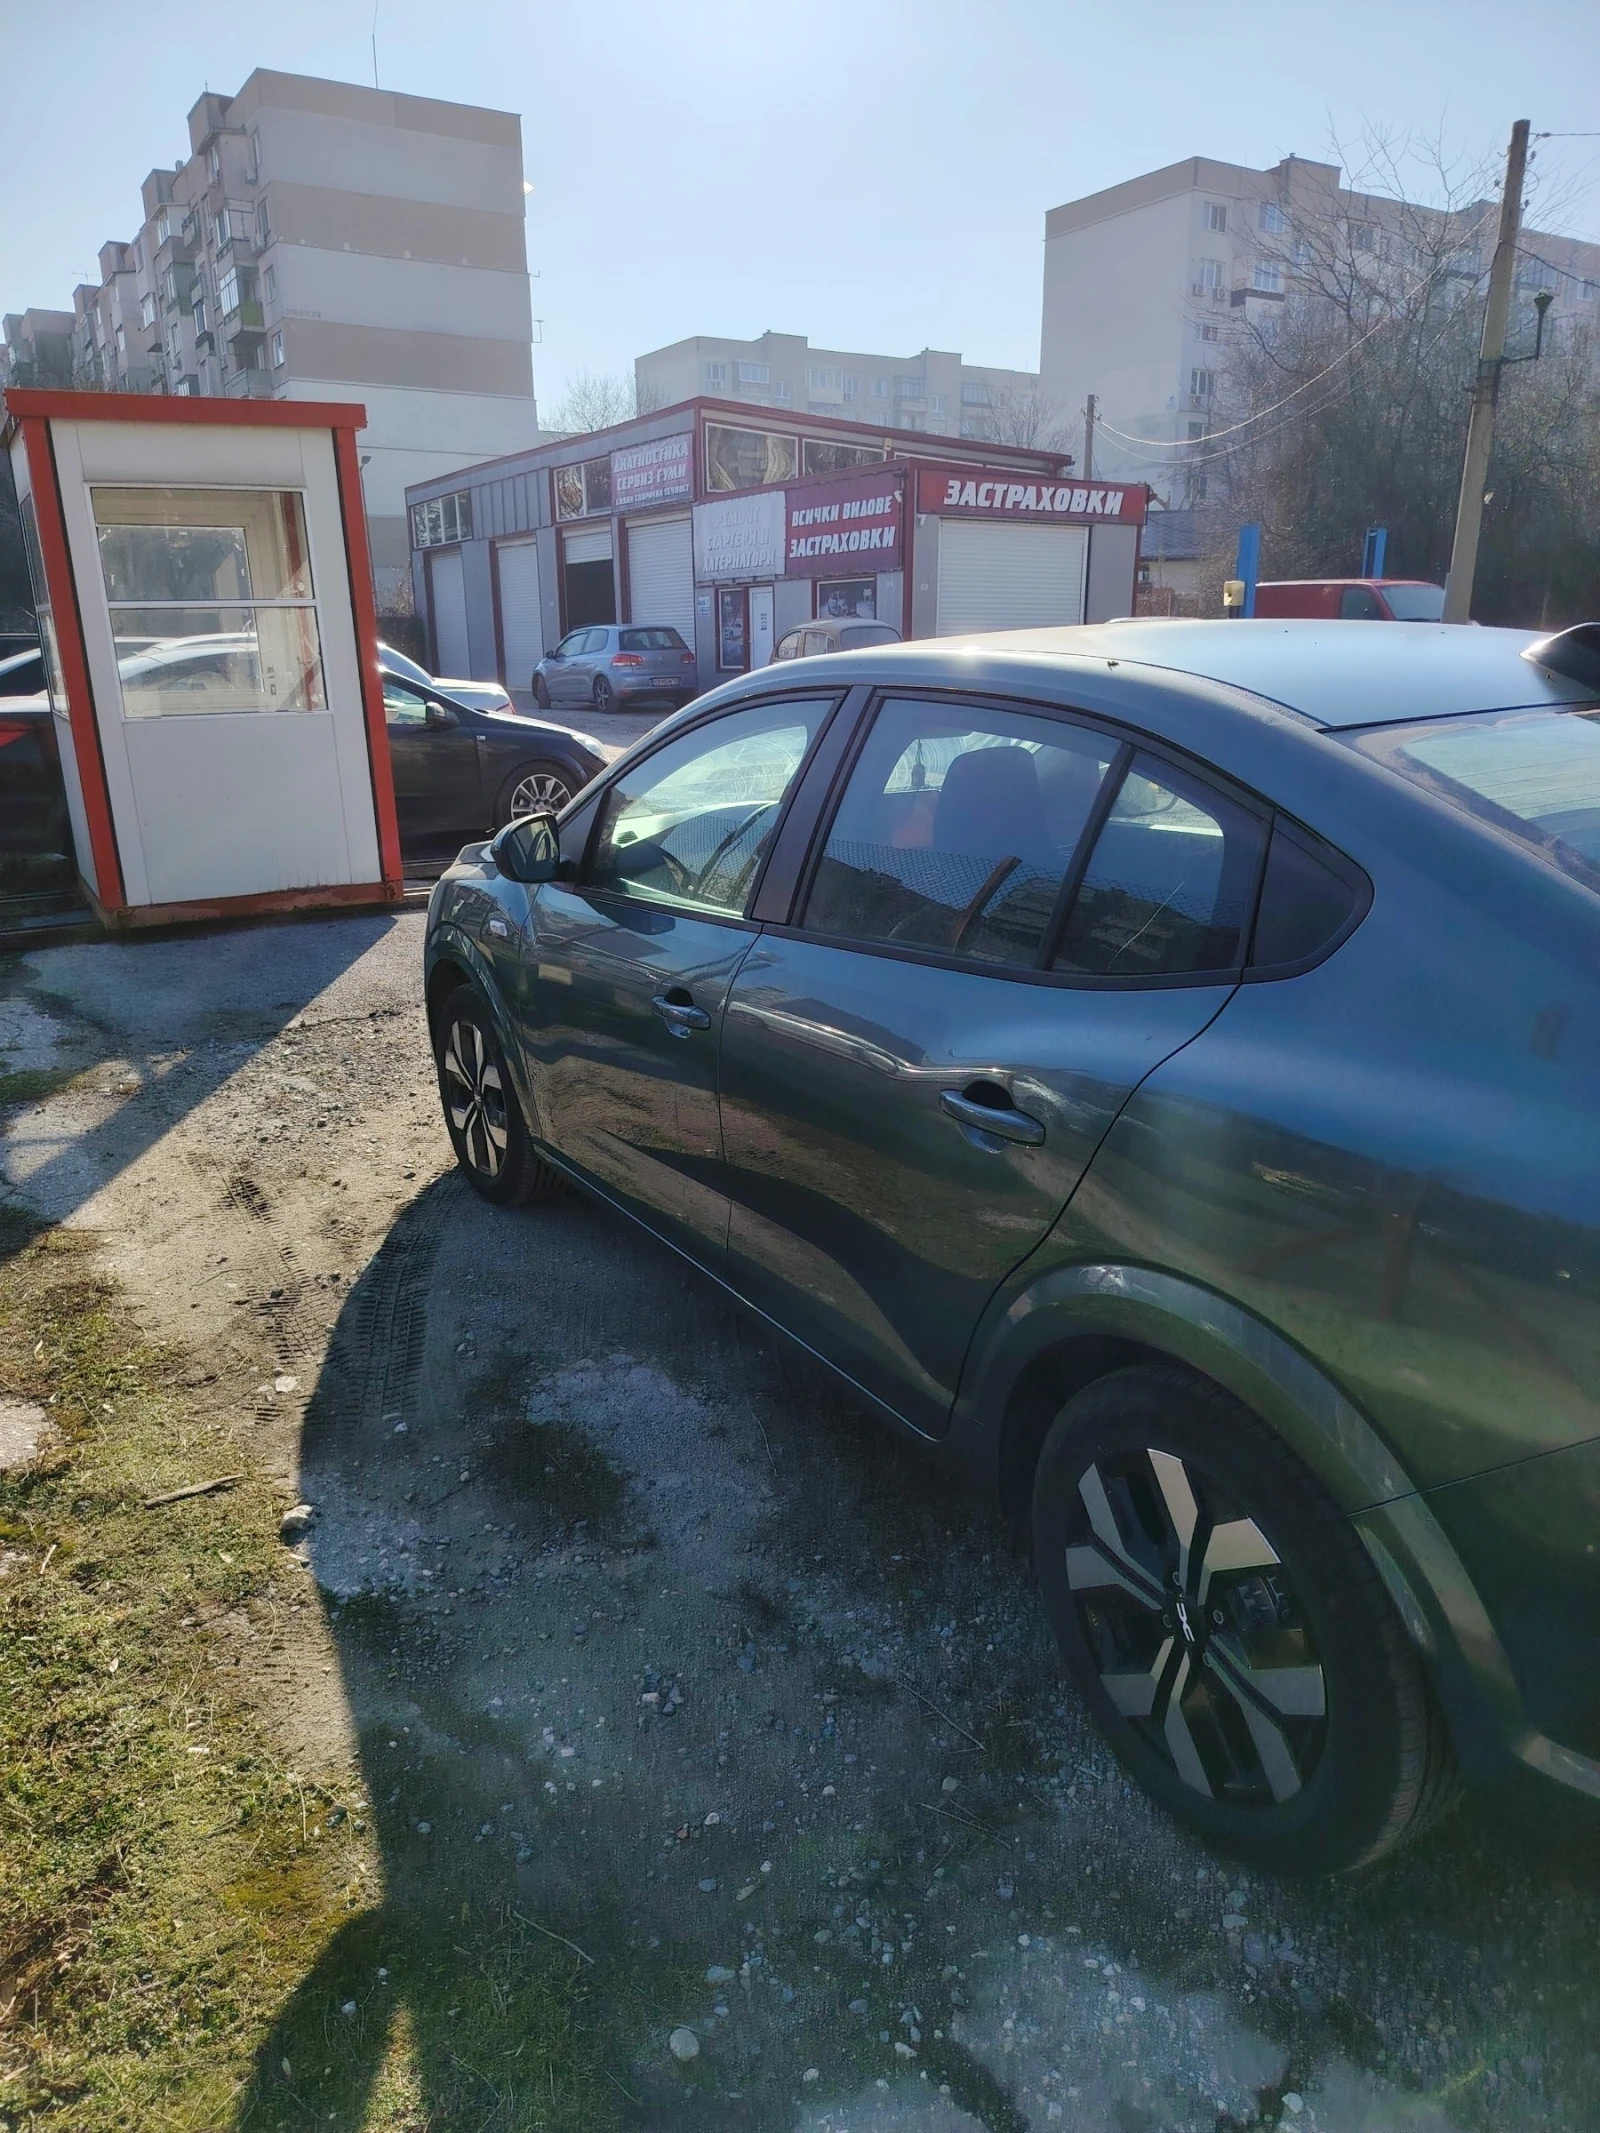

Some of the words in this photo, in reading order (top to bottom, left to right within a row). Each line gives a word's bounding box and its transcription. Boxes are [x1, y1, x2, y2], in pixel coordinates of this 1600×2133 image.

[613, 441, 689, 474] ДИАГНОСТИКА
[616, 470, 654, 492] СЕРВИЗ
[656, 463, 687, 483] ГУМИ
[791, 504, 840, 528] ВСИЧКИ
[842, 495, 893, 520] ВИДОВЕ
[943, 479, 1124, 516] ЗАСТРАХОВКИ
[708, 529, 759, 552] СТАРТЕРИ
[789, 526, 896, 559] ЗАСТРАХОВКИ
[703, 549, 776, 574] АЛТЕРНАТОРИ
